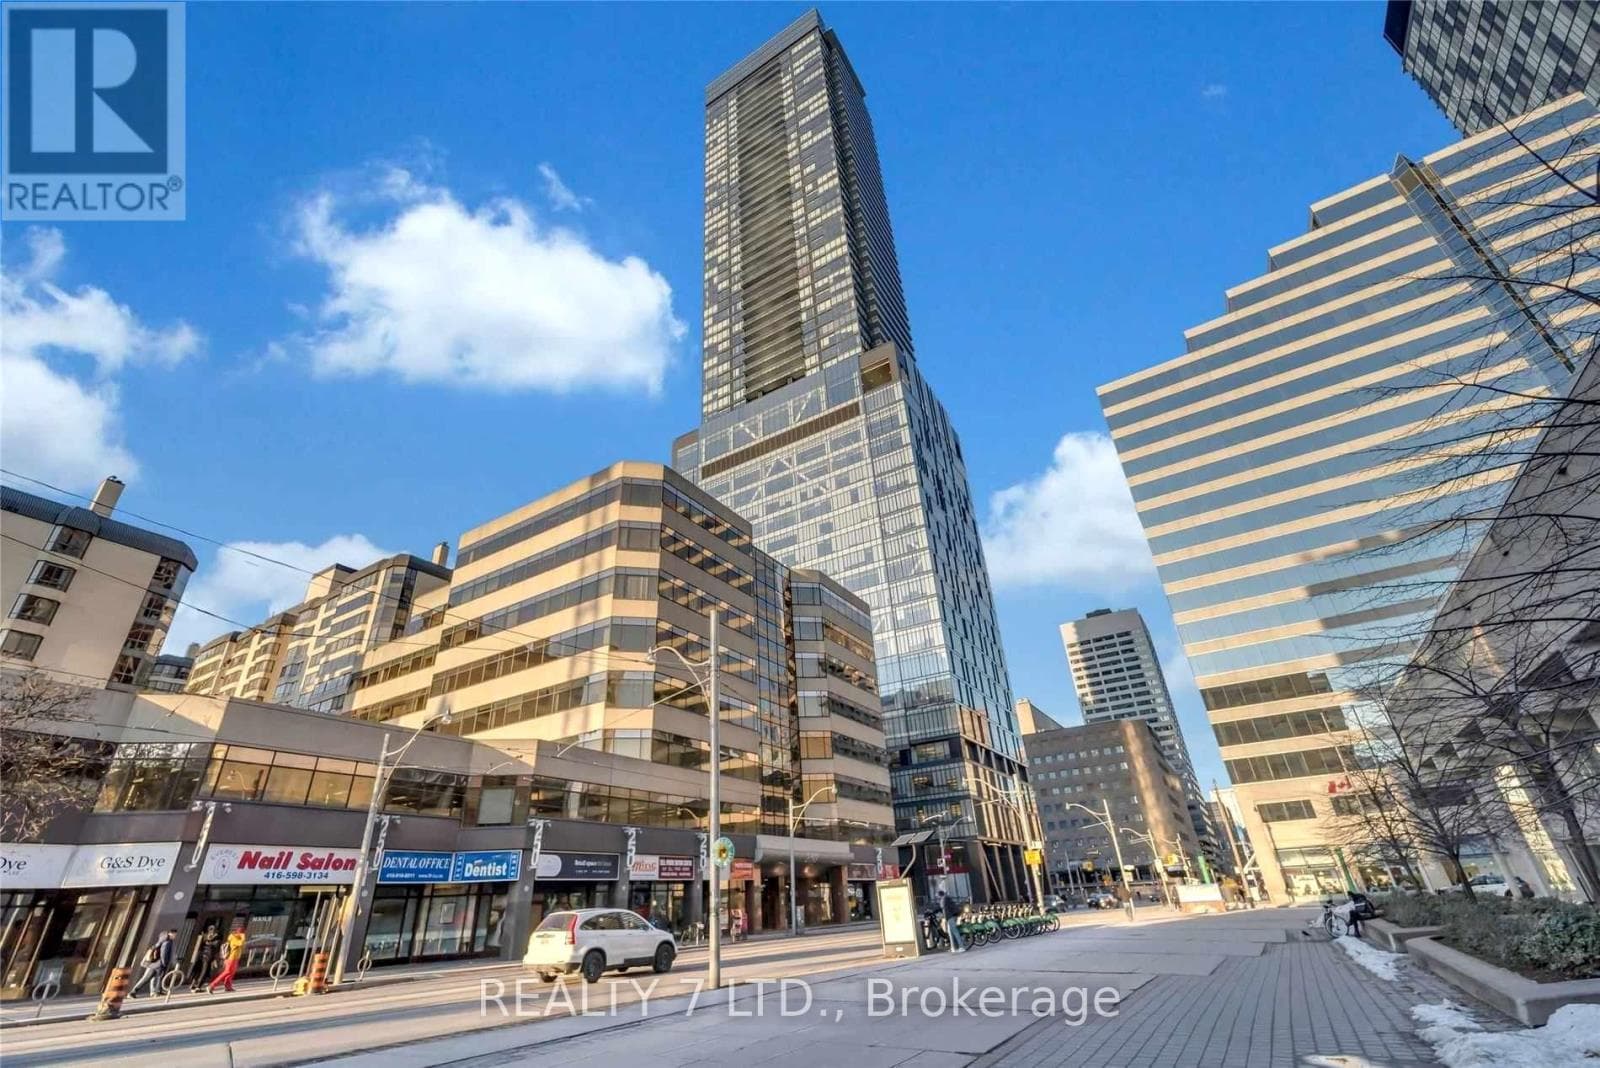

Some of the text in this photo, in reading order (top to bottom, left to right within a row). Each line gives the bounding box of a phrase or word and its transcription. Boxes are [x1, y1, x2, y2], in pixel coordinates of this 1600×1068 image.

[627, 828, 636, 868] 250
[100, 856, 166, 872] G&S Dye
[237, 851, 293, 870] Nail
[296, 852, 358, 871] Salon
[383, 857, 452, 869] DENTAL OFFICE
[263, 871, 329, 880] 416-598-3134
[464, 862, 507, 877] Dentist
